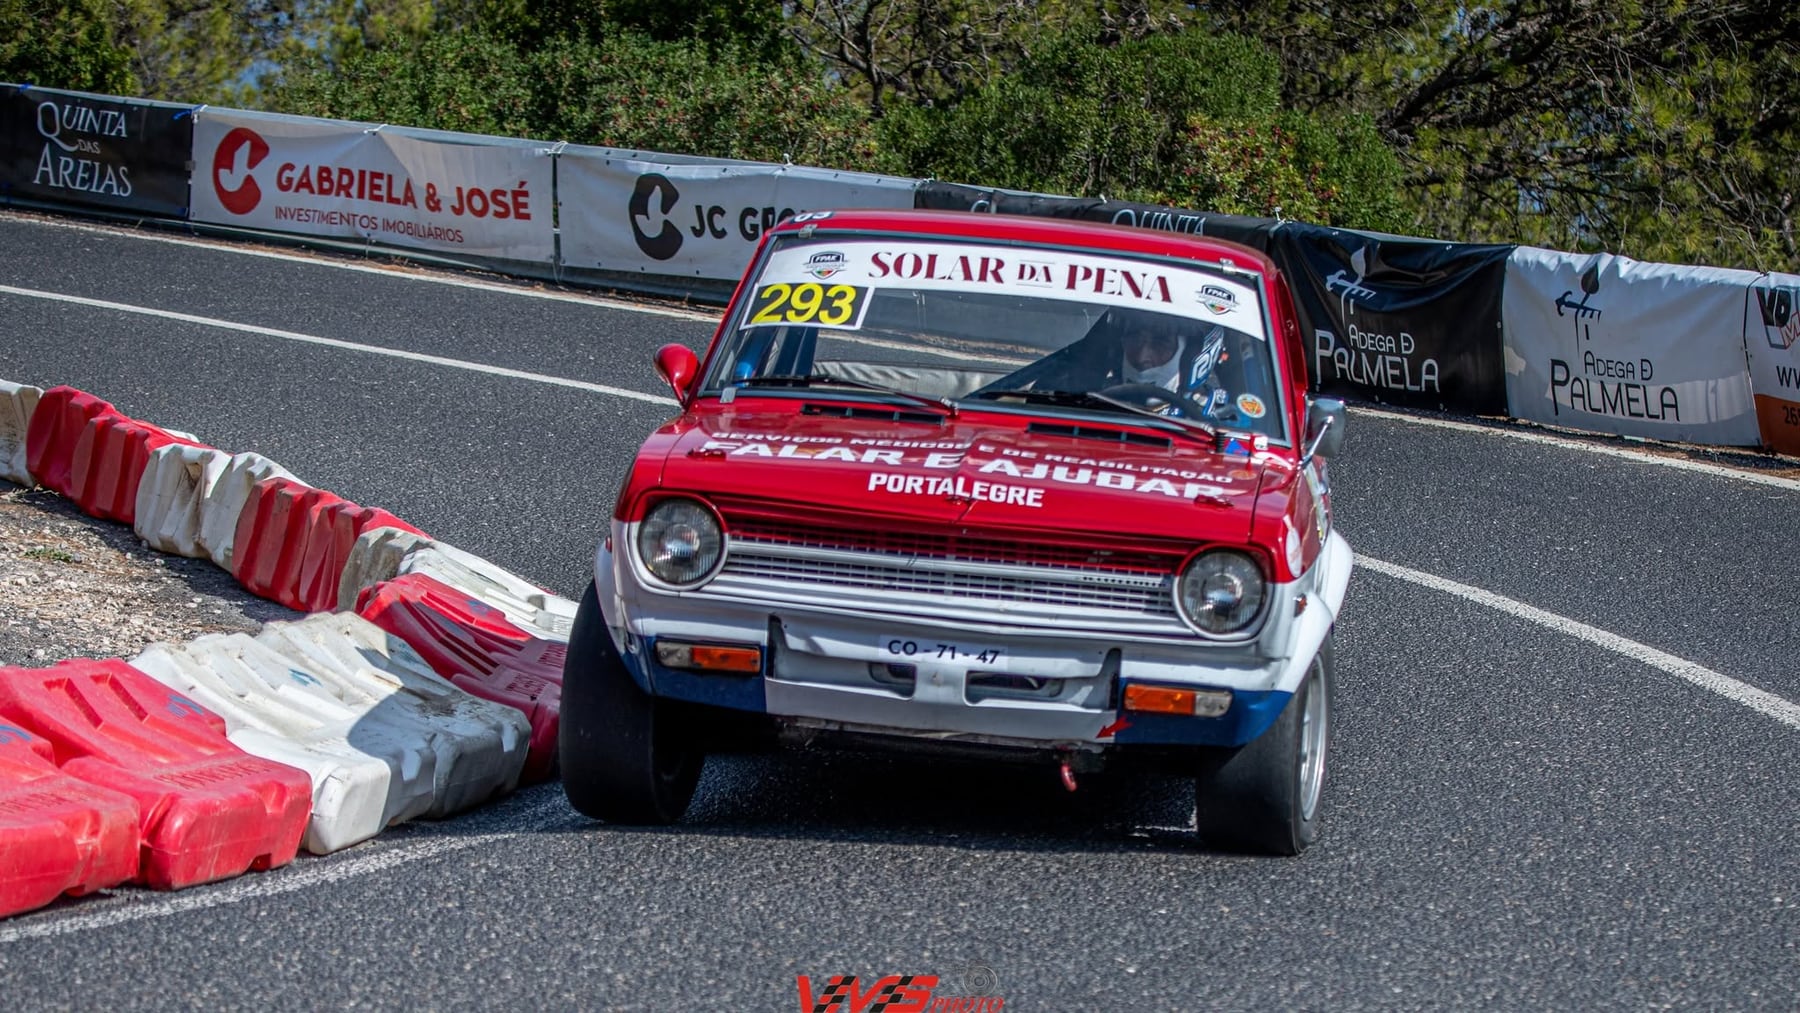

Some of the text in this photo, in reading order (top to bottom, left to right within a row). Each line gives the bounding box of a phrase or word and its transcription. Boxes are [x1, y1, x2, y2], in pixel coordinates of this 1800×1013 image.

[37, 102, 128, 152] QUINTA
[78, 139, 101, 154] DAS
[32, 142, 132, 197] AREIAS
[276, 162, 532, 221] GABRIELA & JOSÉ
[275, 206, 464, 243] INVESTIMENTOS IMOBILIÁRIOS
[690, 205, 727, 239] JC
[868, 251, 1174, 303] SOLAR DA PENA
[751, 282, 857, 326] 293
[1315, 329, 1440, 392] PALMELA
[1348, 324, 1396, 353] ADEGA
[1584, 350, 1635, 380] ADEGA
[1550, 359, 1680, 421] PALMELA
[700, 441, 1226, 501] FALAR E AJUDAR
[1003, 449, 1038, 459] DE
[868, 472, 1045, 508] PORTALEGRE
